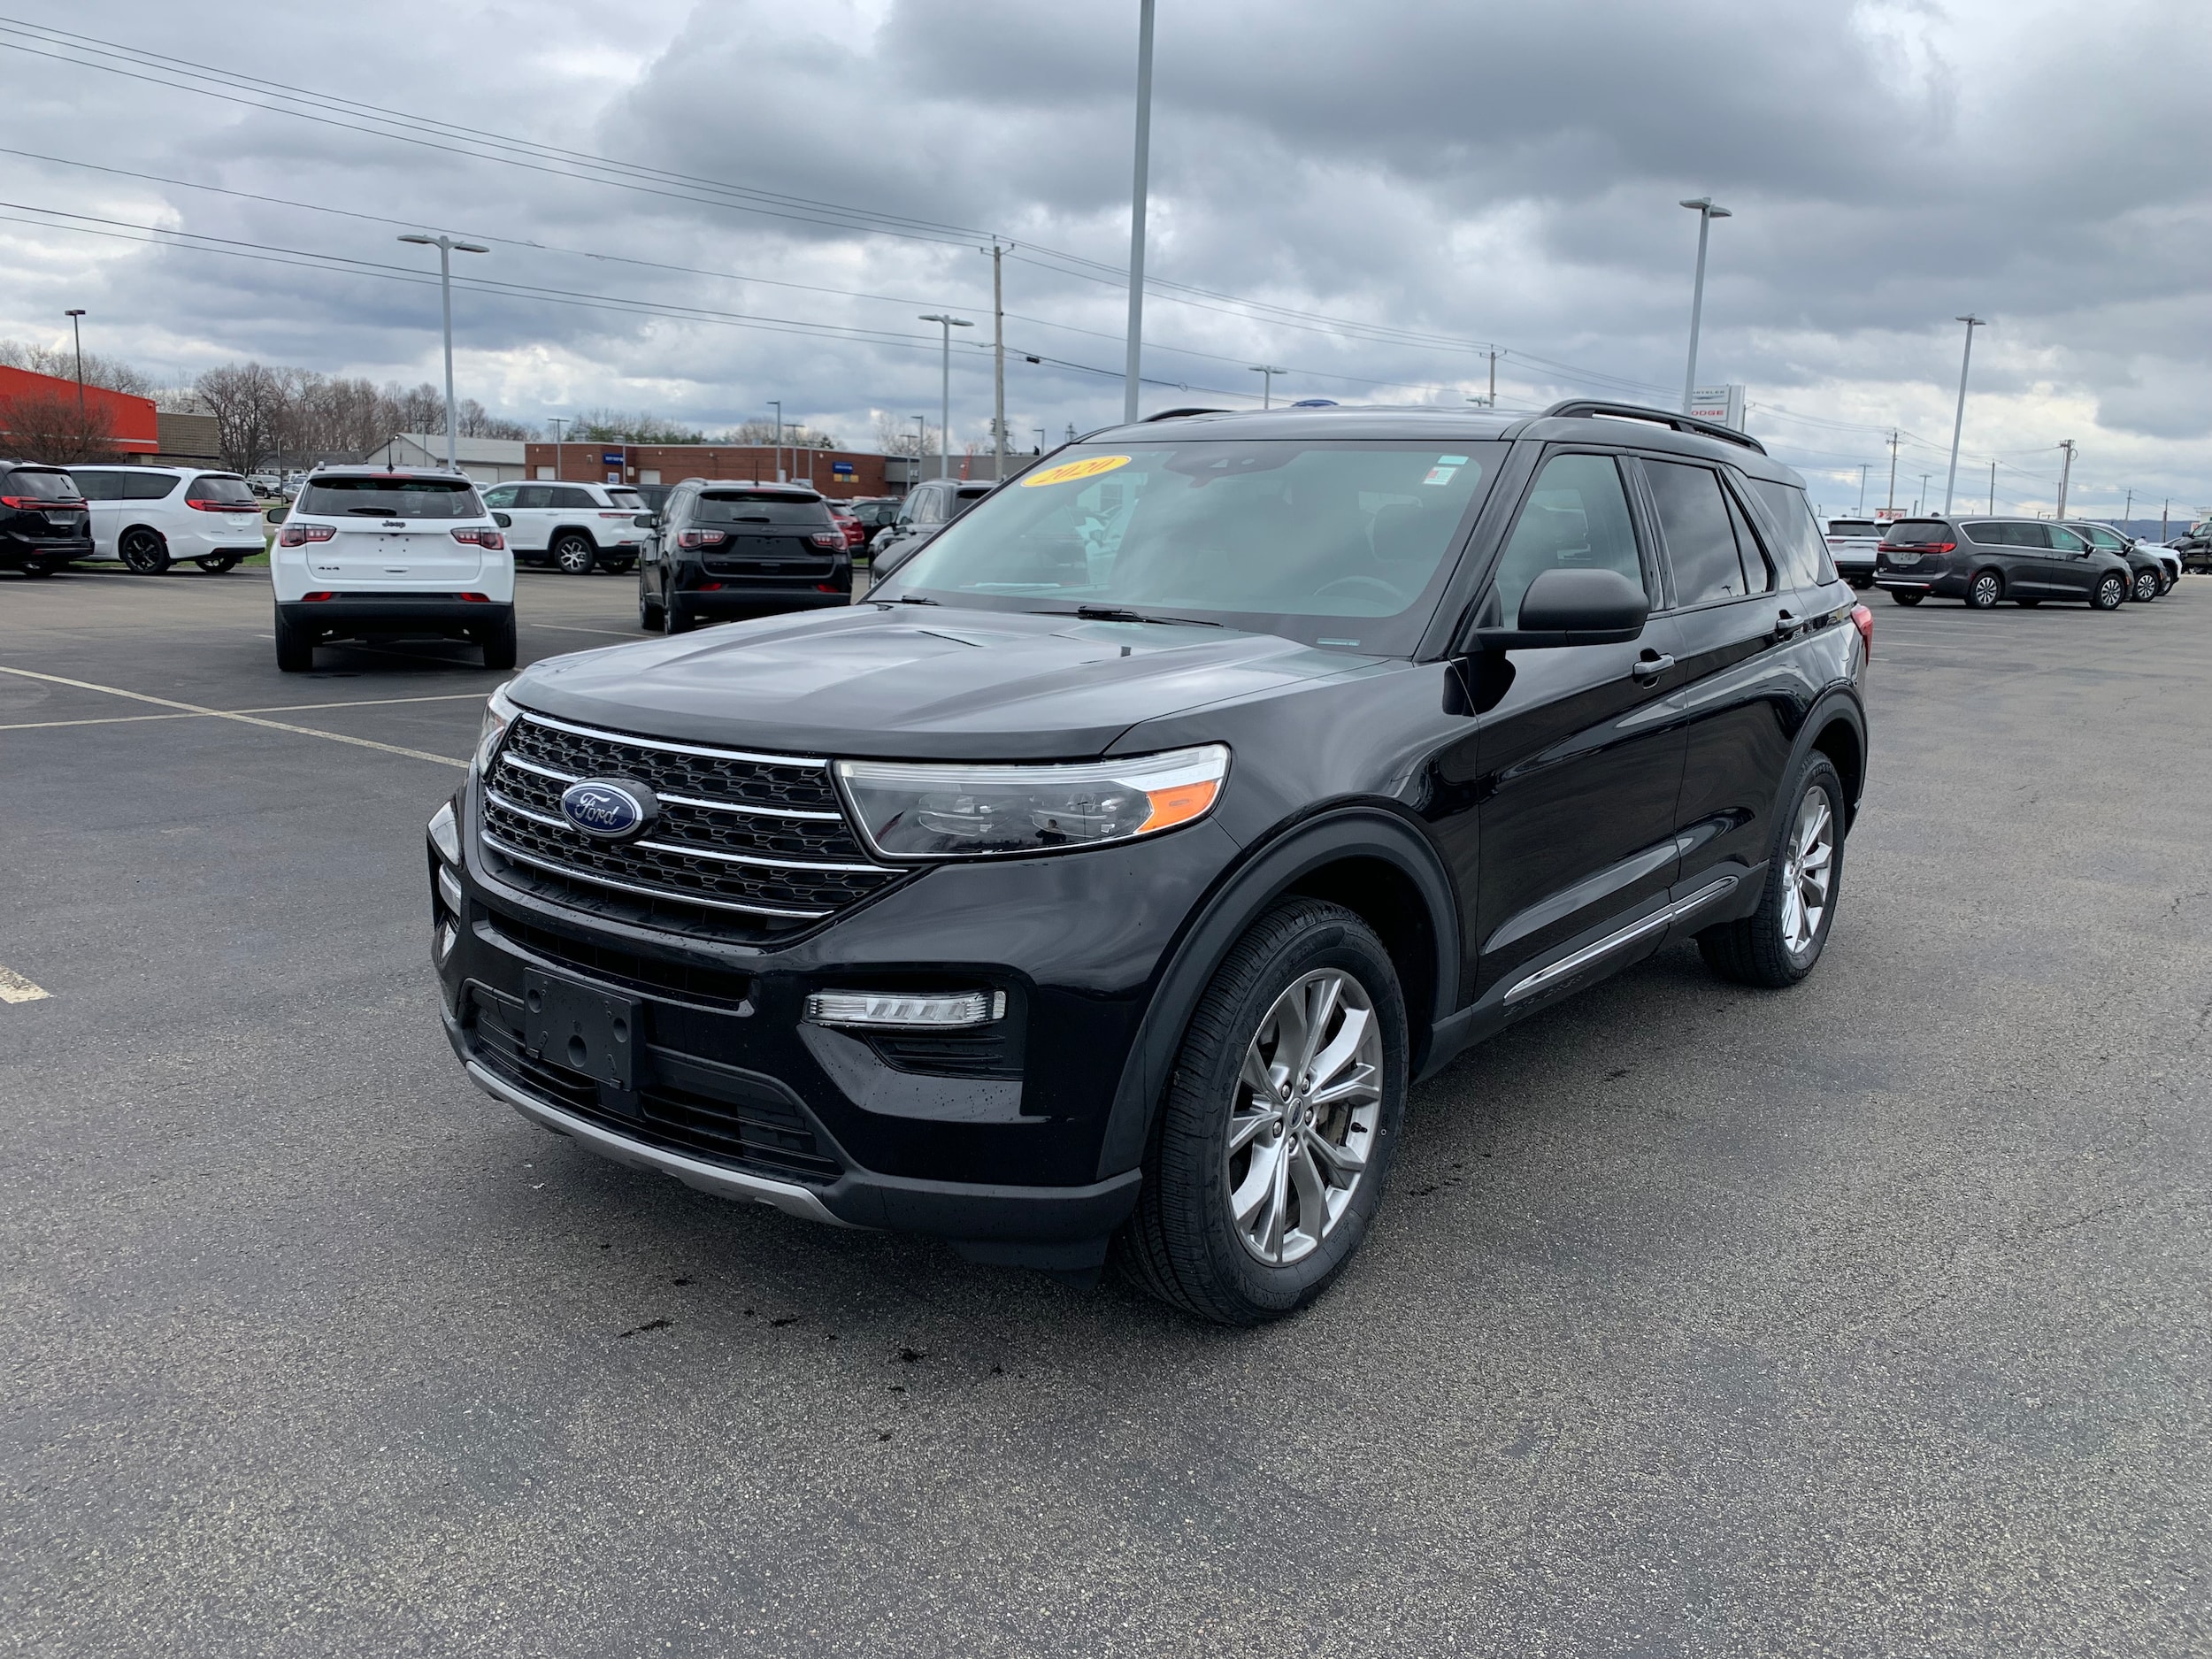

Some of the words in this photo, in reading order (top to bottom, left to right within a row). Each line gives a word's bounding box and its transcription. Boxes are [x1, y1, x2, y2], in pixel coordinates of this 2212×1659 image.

[1033, 458, 1116, 484] 2020
[381, 519, 406, 528] Jeep
[574, 792, 619, 826] Ford
